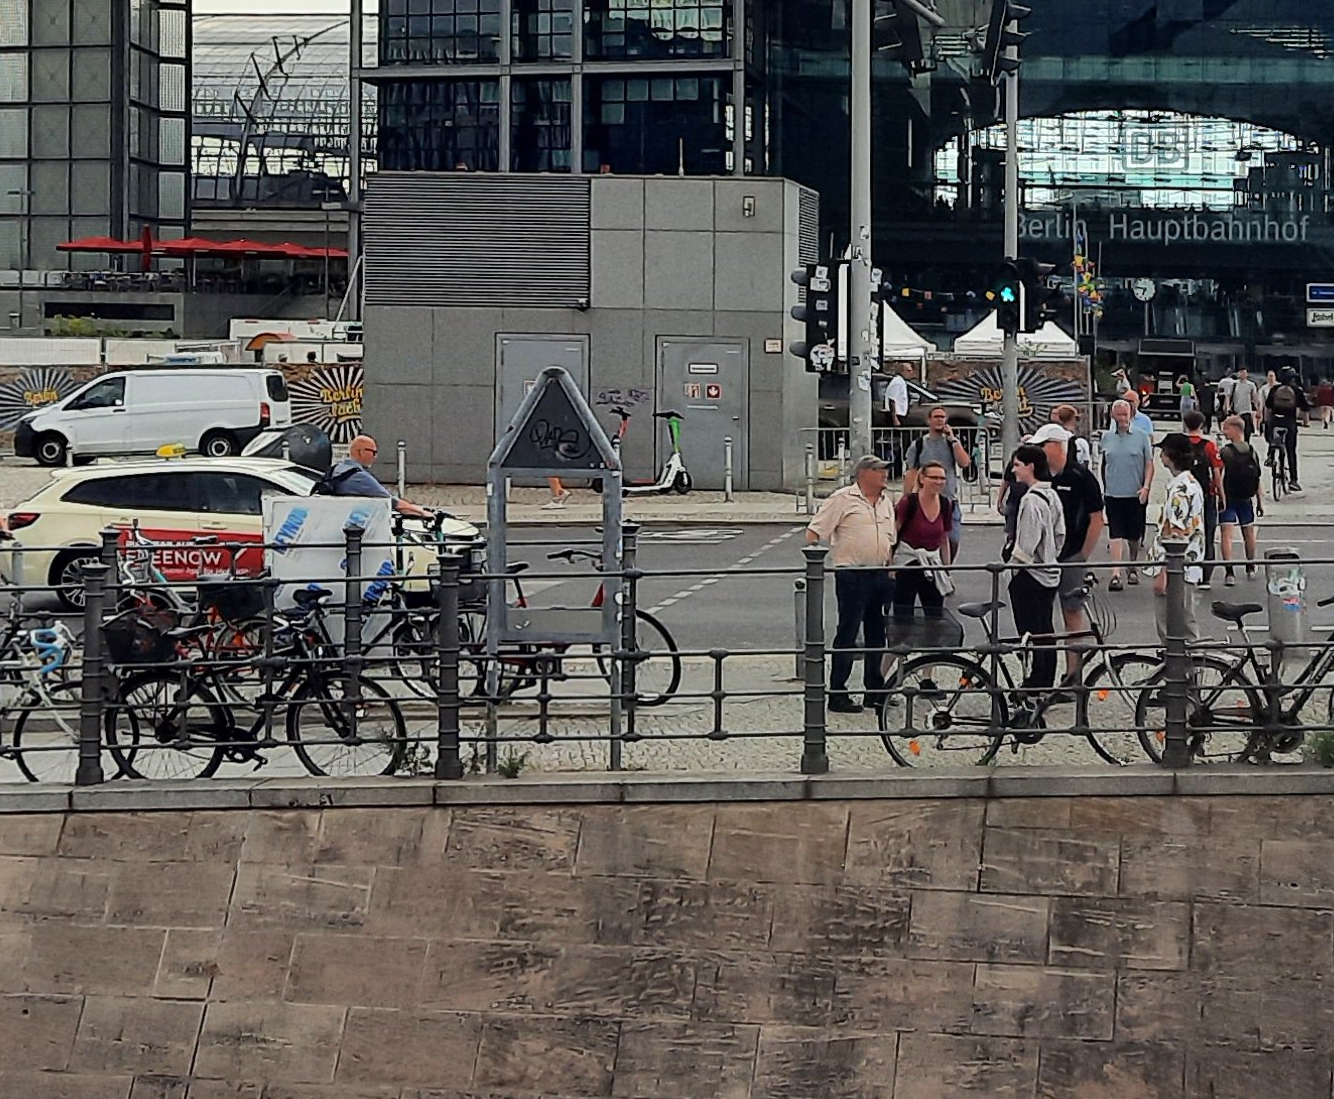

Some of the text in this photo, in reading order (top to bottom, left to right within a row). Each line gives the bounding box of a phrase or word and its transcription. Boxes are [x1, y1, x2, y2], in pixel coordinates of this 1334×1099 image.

[1130, 131, 1181, 165] DB
[1017, 212, 1310, 246] Berlin Hauptbahnhof
[320, 385, 364, 403] Berlin
[329, 398, 362, 423] lach
